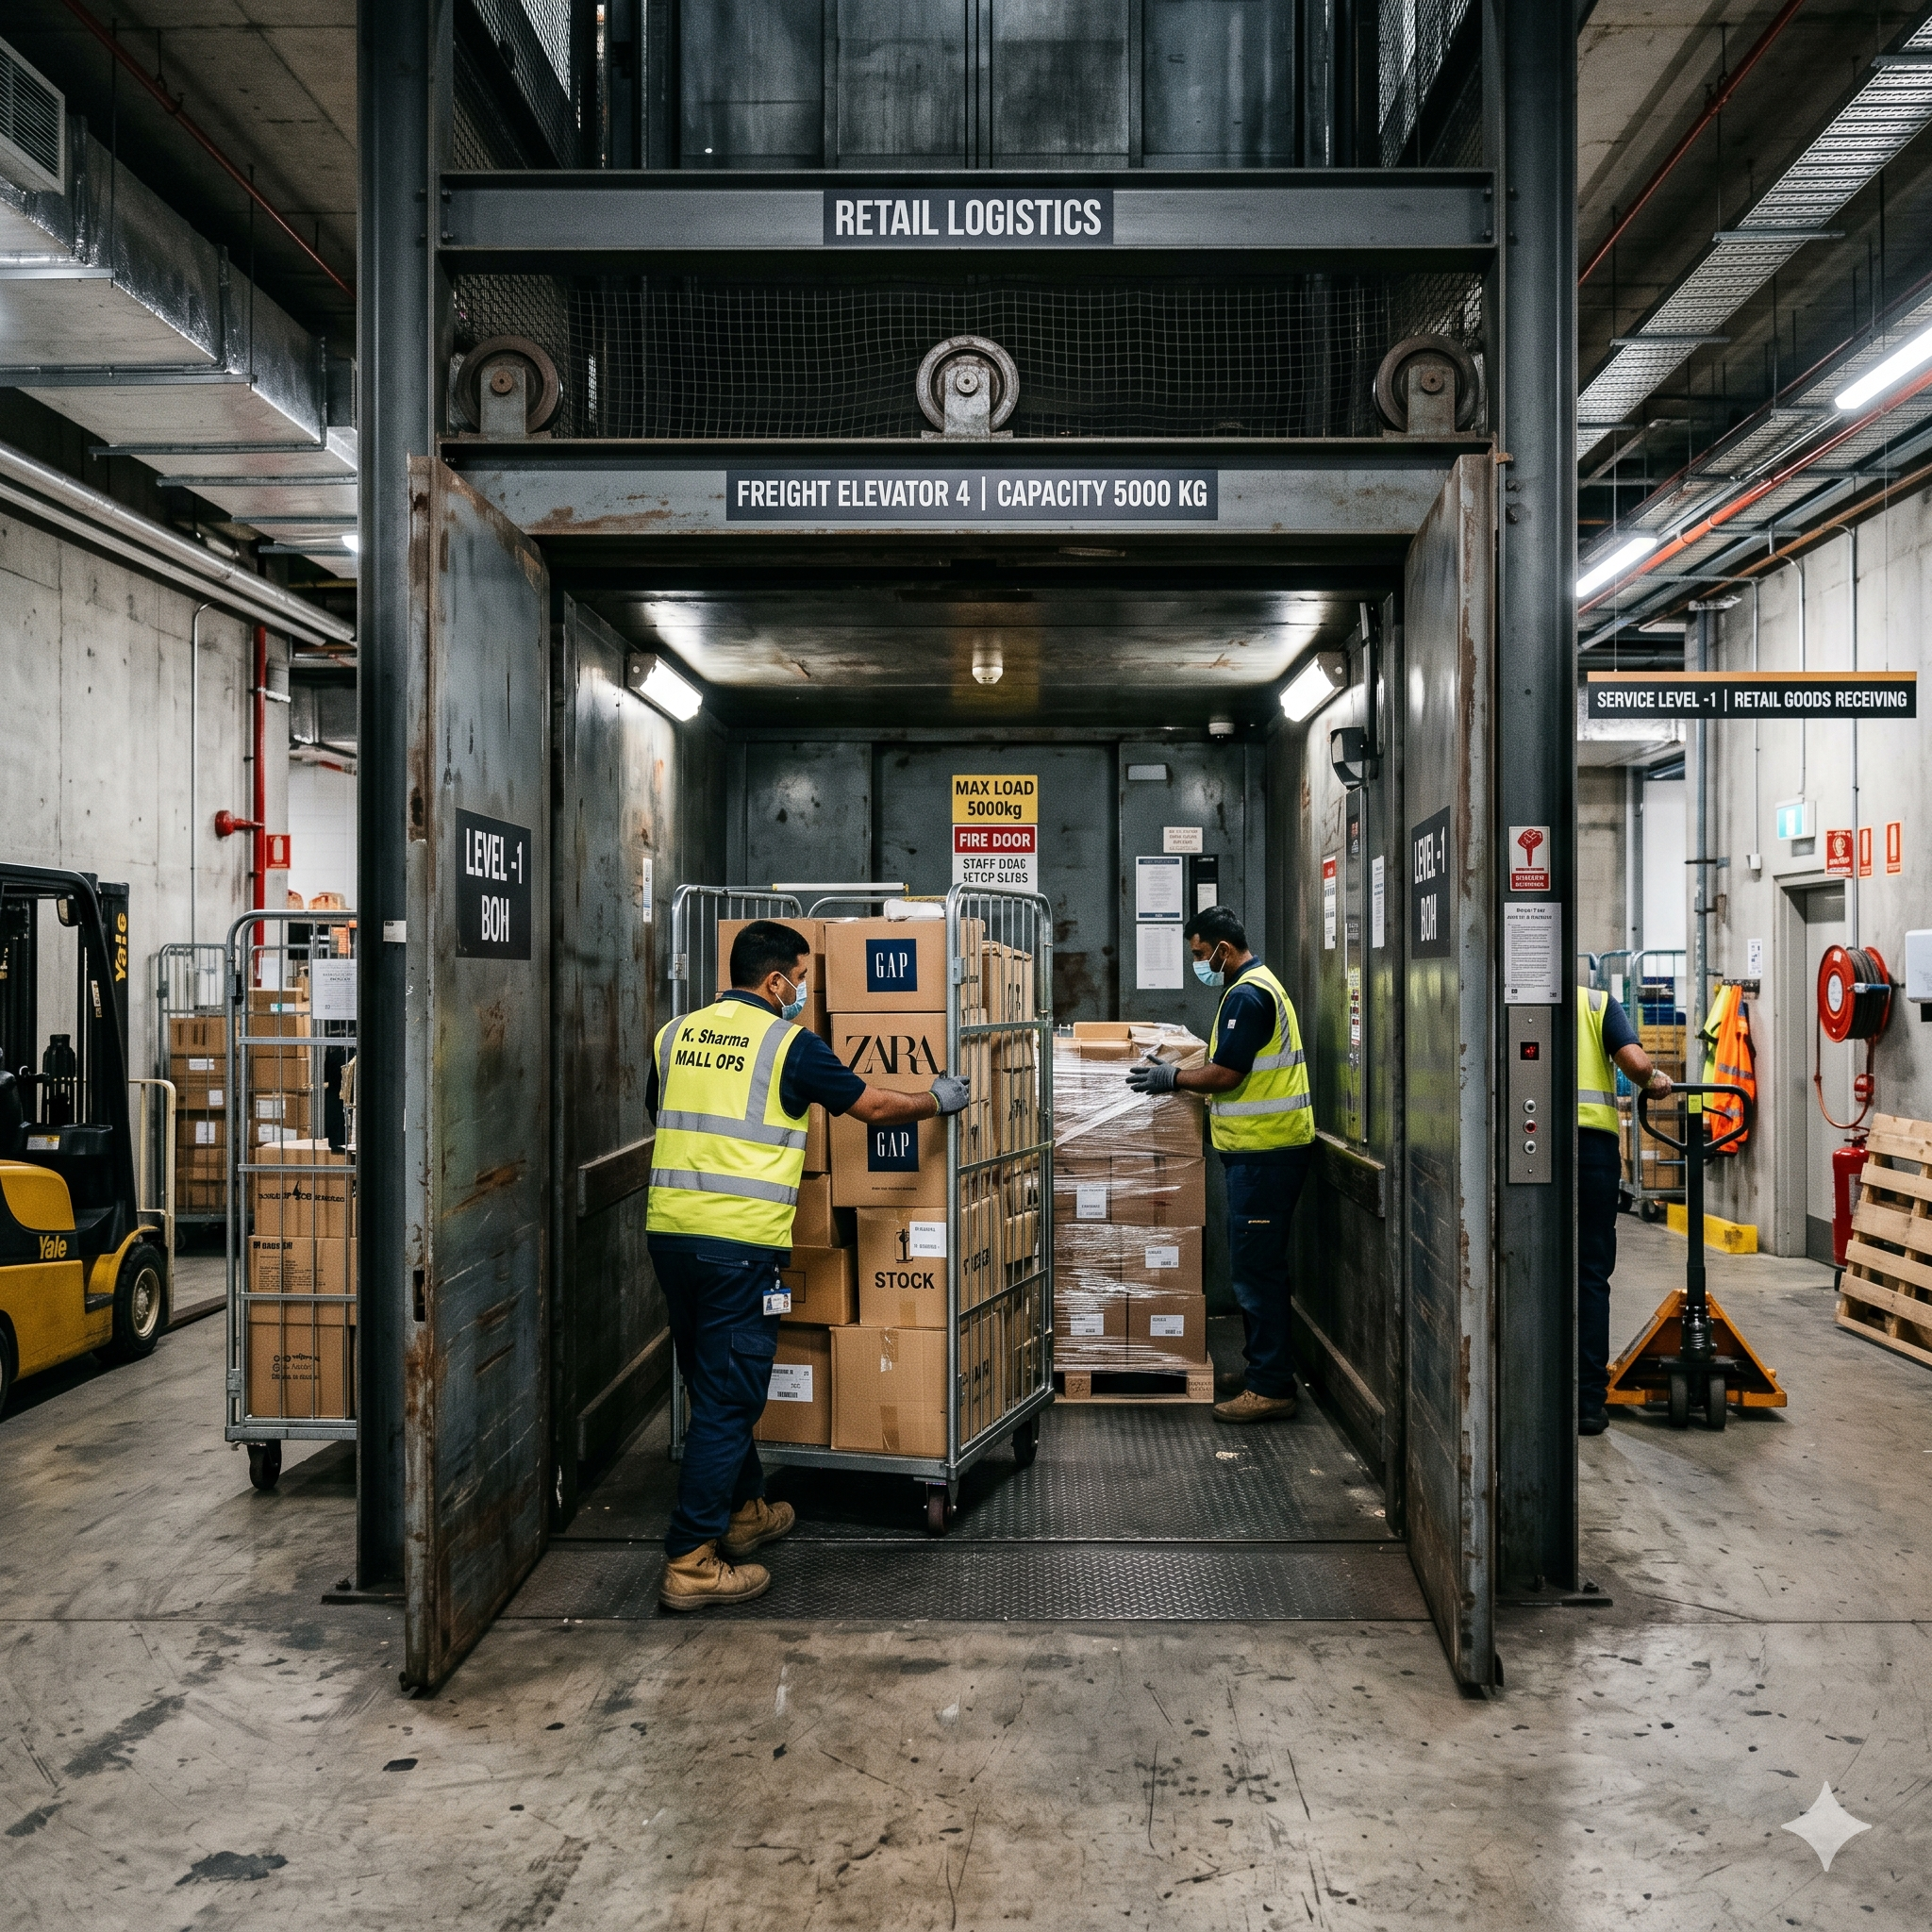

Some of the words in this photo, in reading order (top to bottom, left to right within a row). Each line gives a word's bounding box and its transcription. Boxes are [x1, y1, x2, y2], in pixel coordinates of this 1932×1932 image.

[835, 199, 939, 236] RETAIL
[947, 199, 1102, 236] LOGISTICS
[736, 479, 831, 507] FREIGHT
[838, 479, 949, 507] ELEVATOR
[956, 479, 971, 507] 4
[997, 479, 1108, 507] CAPACITY
[1113, 479, 1172, 507] 5000
[1178, 479, 1208, 507] KG
[1597, 691, 1656, 708] SERVICE
[1658, 691, 1700, 708] LEVEL
[1703, 691, 1716, 708] -1
[1734, 691, 1782, 708] RETAIL
[1784, 691, 1832, 708] GOODS
[1835, 691, 1907, 708] RECEIVING
[956, 780, 991, 795] MAX
[994, 780, 1035, 795] LOAD
[967, 801, 1023, 820] 5000kg
[959, 832, 989, 847] FIRE
[992, 832, 1031, 847] DOOR
[465, 827, 508, 882] LEVEL
[510, 841, 523, 885] -1
[963, 858, 996, 869] STAFF
[1414, 832, 1436, 885] LEVEL
[1437, 825, 1445, 874] -1
[481, 894, 509, 942] BOH
[1421, 893, 1437, 941] BOH
[875, 952, 908, 978] GAP
[681, 1027, 694, 1042] K.
[698, 1028, 750, 1048] Sharma
[675, 1050, 711, 1068] MALL
[715, 1053, 745, 1072] OPS
[845, 1035, 941, 1075] ZARA
[876, 1132, 909, 1158] GAP
[39, 1235, 68, 1259] Yale
[874, 1271, 935, 1290] STOCK
